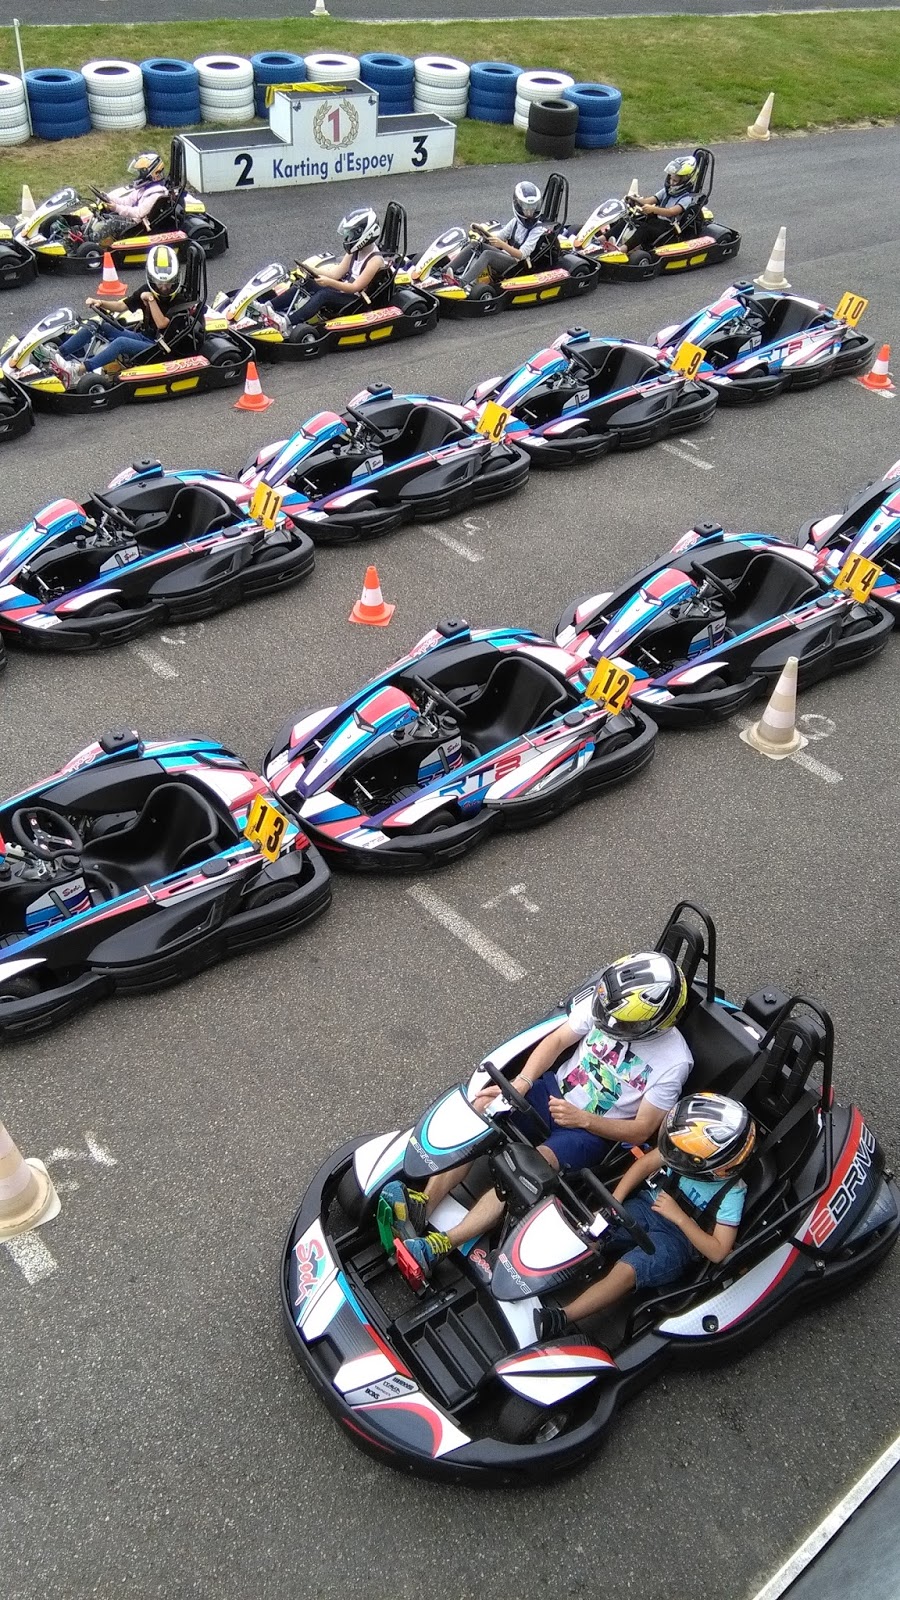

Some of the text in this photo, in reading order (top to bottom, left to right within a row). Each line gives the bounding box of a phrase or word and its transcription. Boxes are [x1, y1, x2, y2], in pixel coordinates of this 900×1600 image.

[328, 107, 340, 143] 1
[273, 152, 394, 179] Karting d'Espoey
[411, 135, 429, 167] 3
[234, 153, 254, 187] 2
[843, 296, 865, 320] 10
[687, 351, 702, 376] 9
[493, 412, 508, 438] 8
[262, 491, 280, 520] 11
[845, 557, 877, 593] 14
[602, 668, 630, 709] 12
[254, 805, 284, 853] 13
